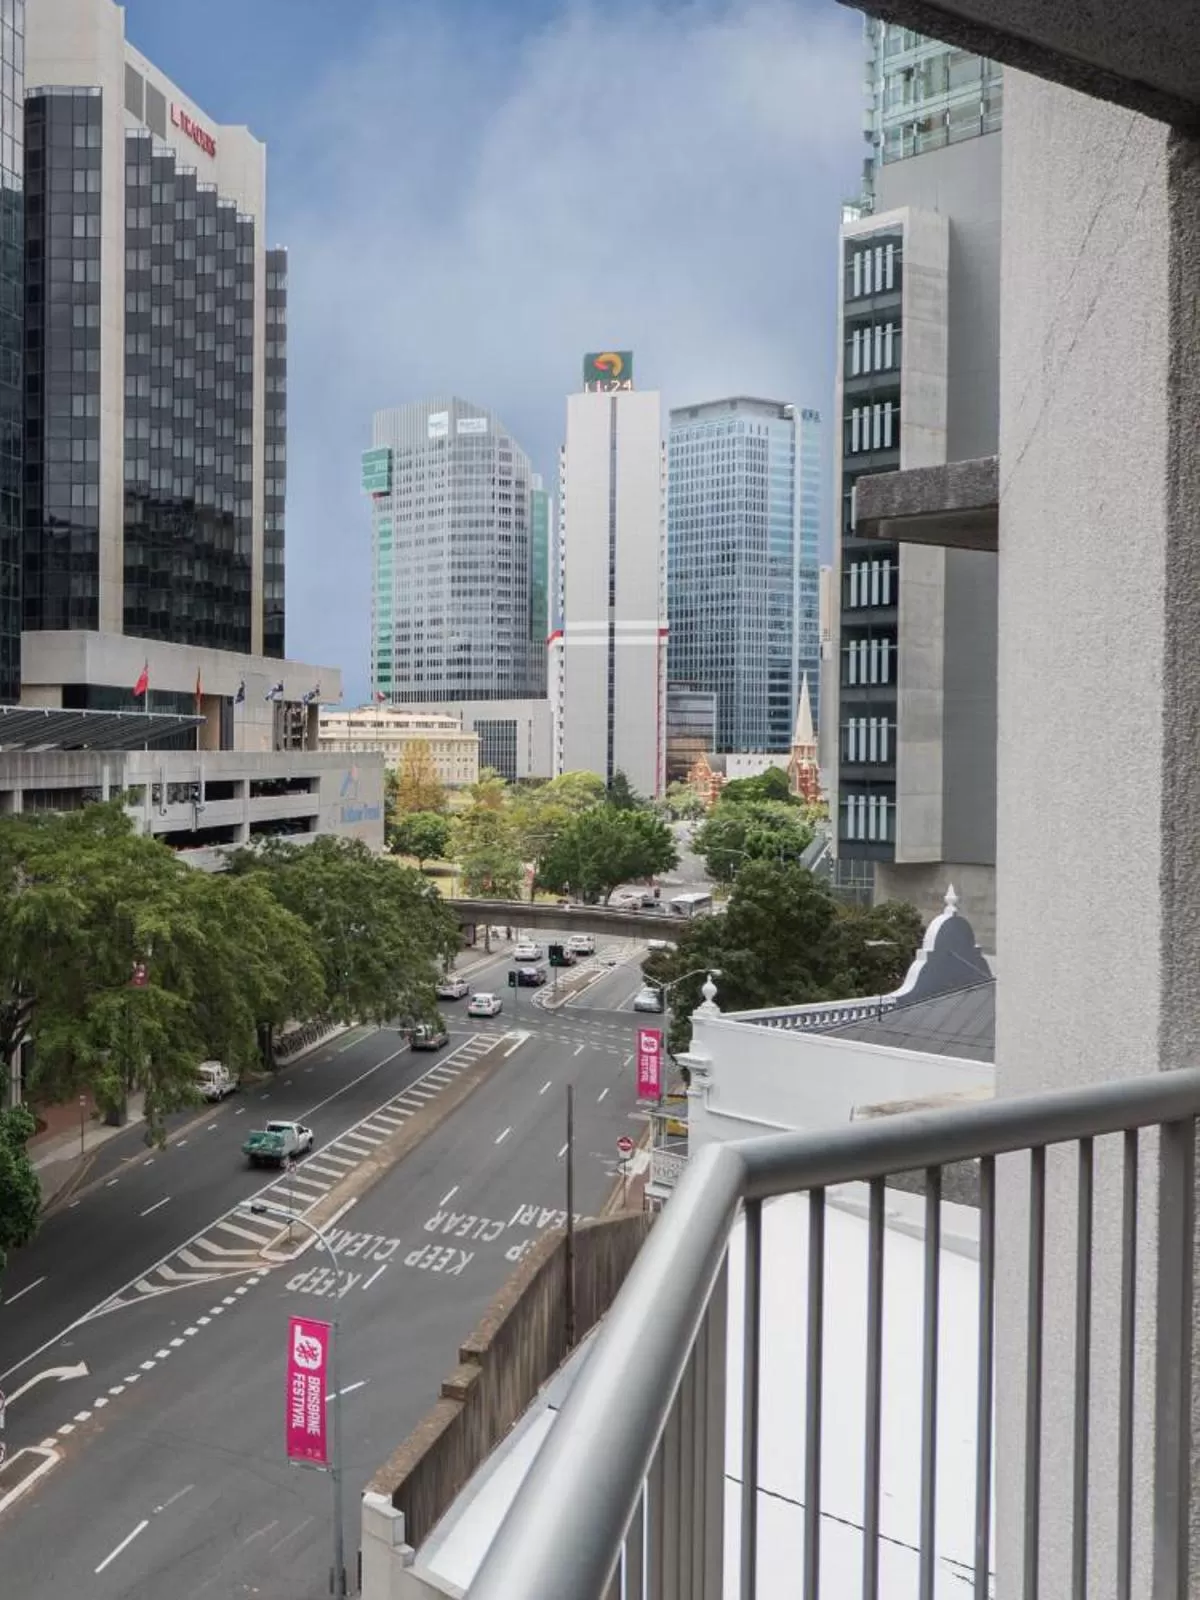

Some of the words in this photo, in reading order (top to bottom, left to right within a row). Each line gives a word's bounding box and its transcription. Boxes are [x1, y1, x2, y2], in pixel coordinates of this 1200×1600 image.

[423, 1209, 505, 1241] CLEAR
[314, 1228, 401, 1261] CLEAR
[403, 1243, 475, 1275] KEEP
[285, 1266, 362, 1299] KEEP
[291, 1372, 306, 1429] FESTIVAL
[306, 1375, 321, 1437] BRISBANE
